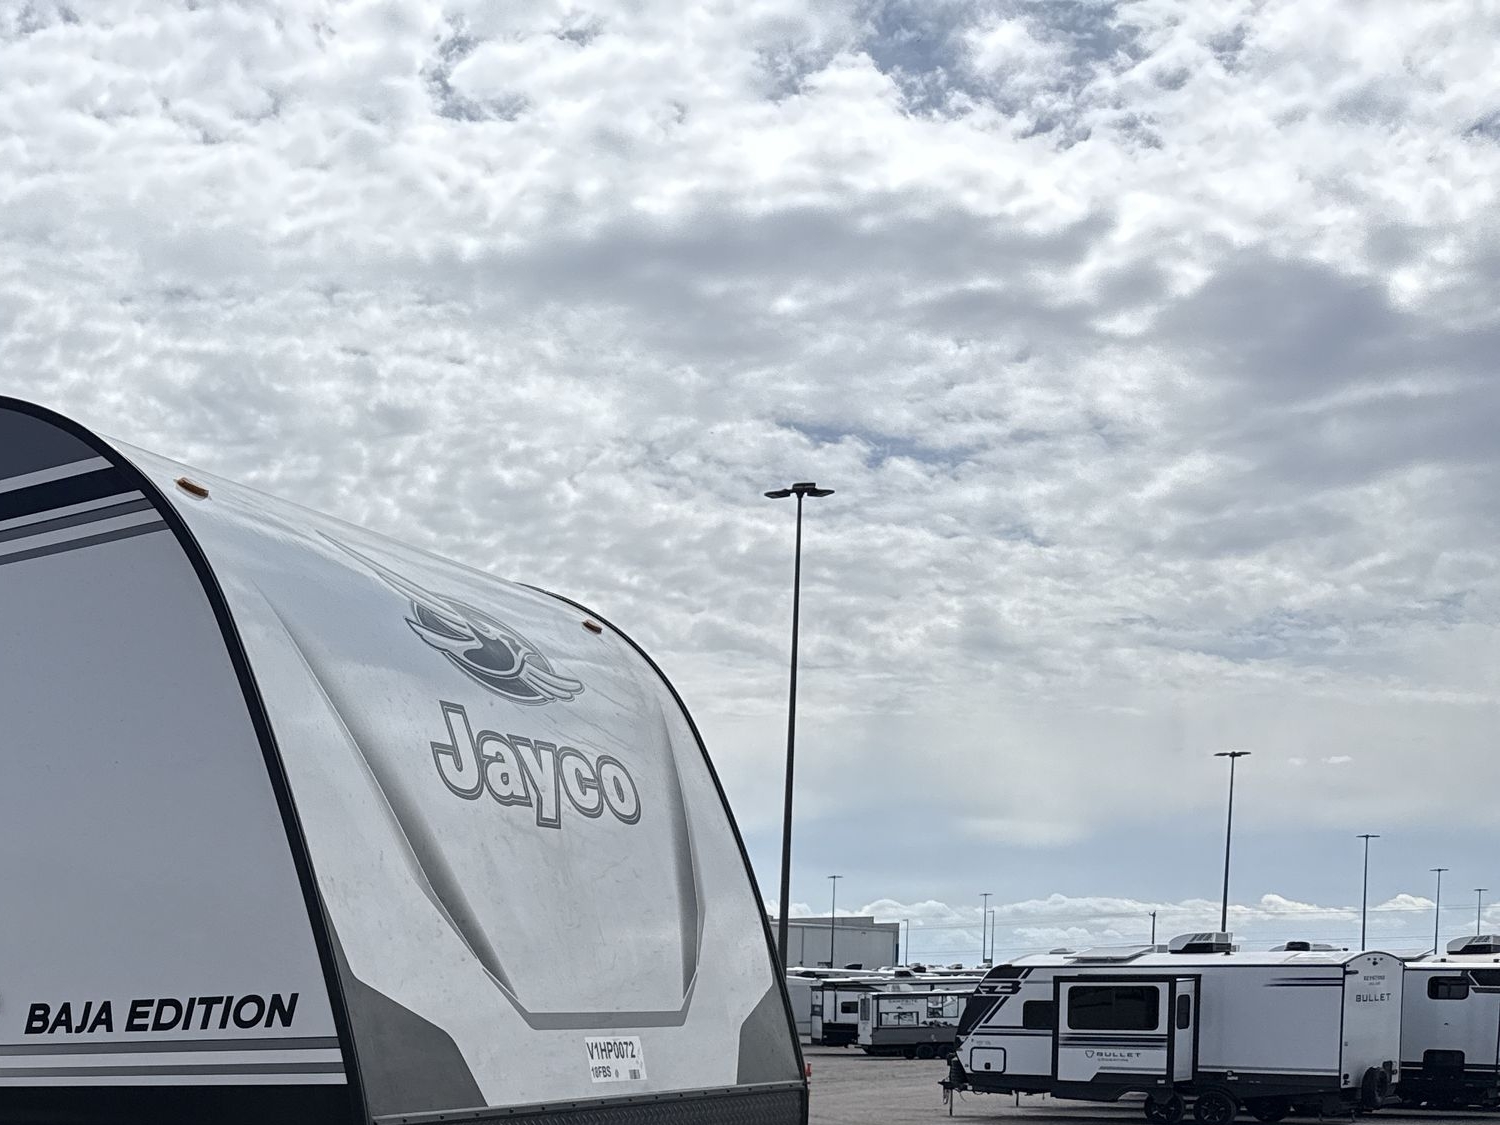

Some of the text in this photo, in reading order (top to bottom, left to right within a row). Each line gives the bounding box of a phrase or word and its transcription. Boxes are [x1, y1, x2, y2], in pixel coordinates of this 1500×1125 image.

[430, 700, 641, 829] Jayco
[1355, 992, 1392, 1002] BULLET
[24, 993, 300, 1035] BAJA EDITION
[586, 1041, 636, 1060] V1HP0072
